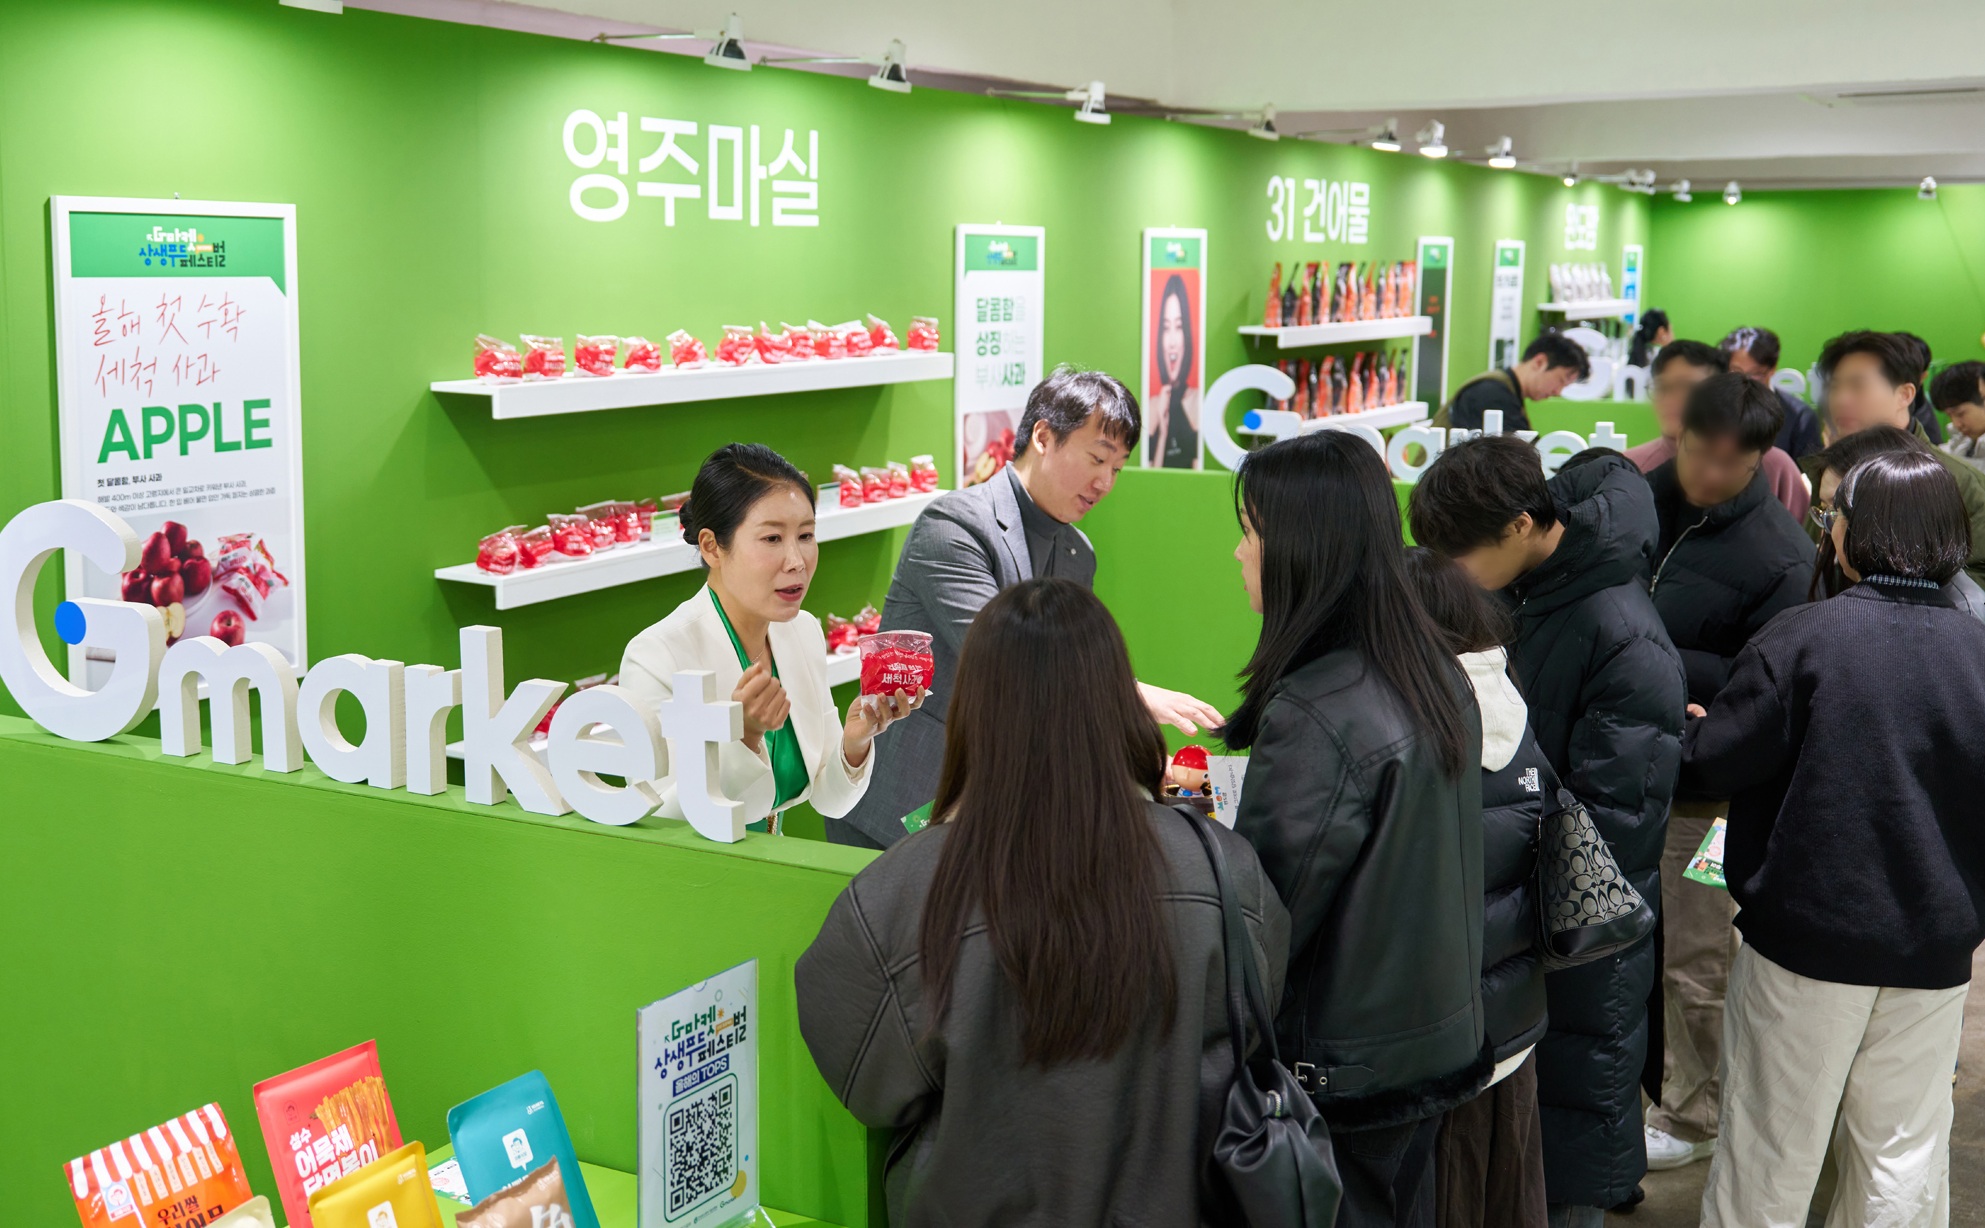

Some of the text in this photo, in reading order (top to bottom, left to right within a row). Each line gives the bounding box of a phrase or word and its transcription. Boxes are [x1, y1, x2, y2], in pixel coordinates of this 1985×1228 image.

[562, 109, 820, 227] 영주마실
[1266, 175, 1371, 244] 31 건어물
[139, 243, 188, 268] 상생푸드
[91, 291, 247, 346] 올해 첫 수확
[94, 346, 221, 399] 세척 사과
[97, 398, 273, 464] APPLE
[148, 472, 163, 482] 사과
[0, 499, 746, 844] Gmarket
[654, 1031, 707, 1080] 상생푸드
[700, 1056, 728, 1081] TOPS
[295, 1123, 355, 1179] 어묵채
[157, 1194, 201, 1227] 우리쌀
